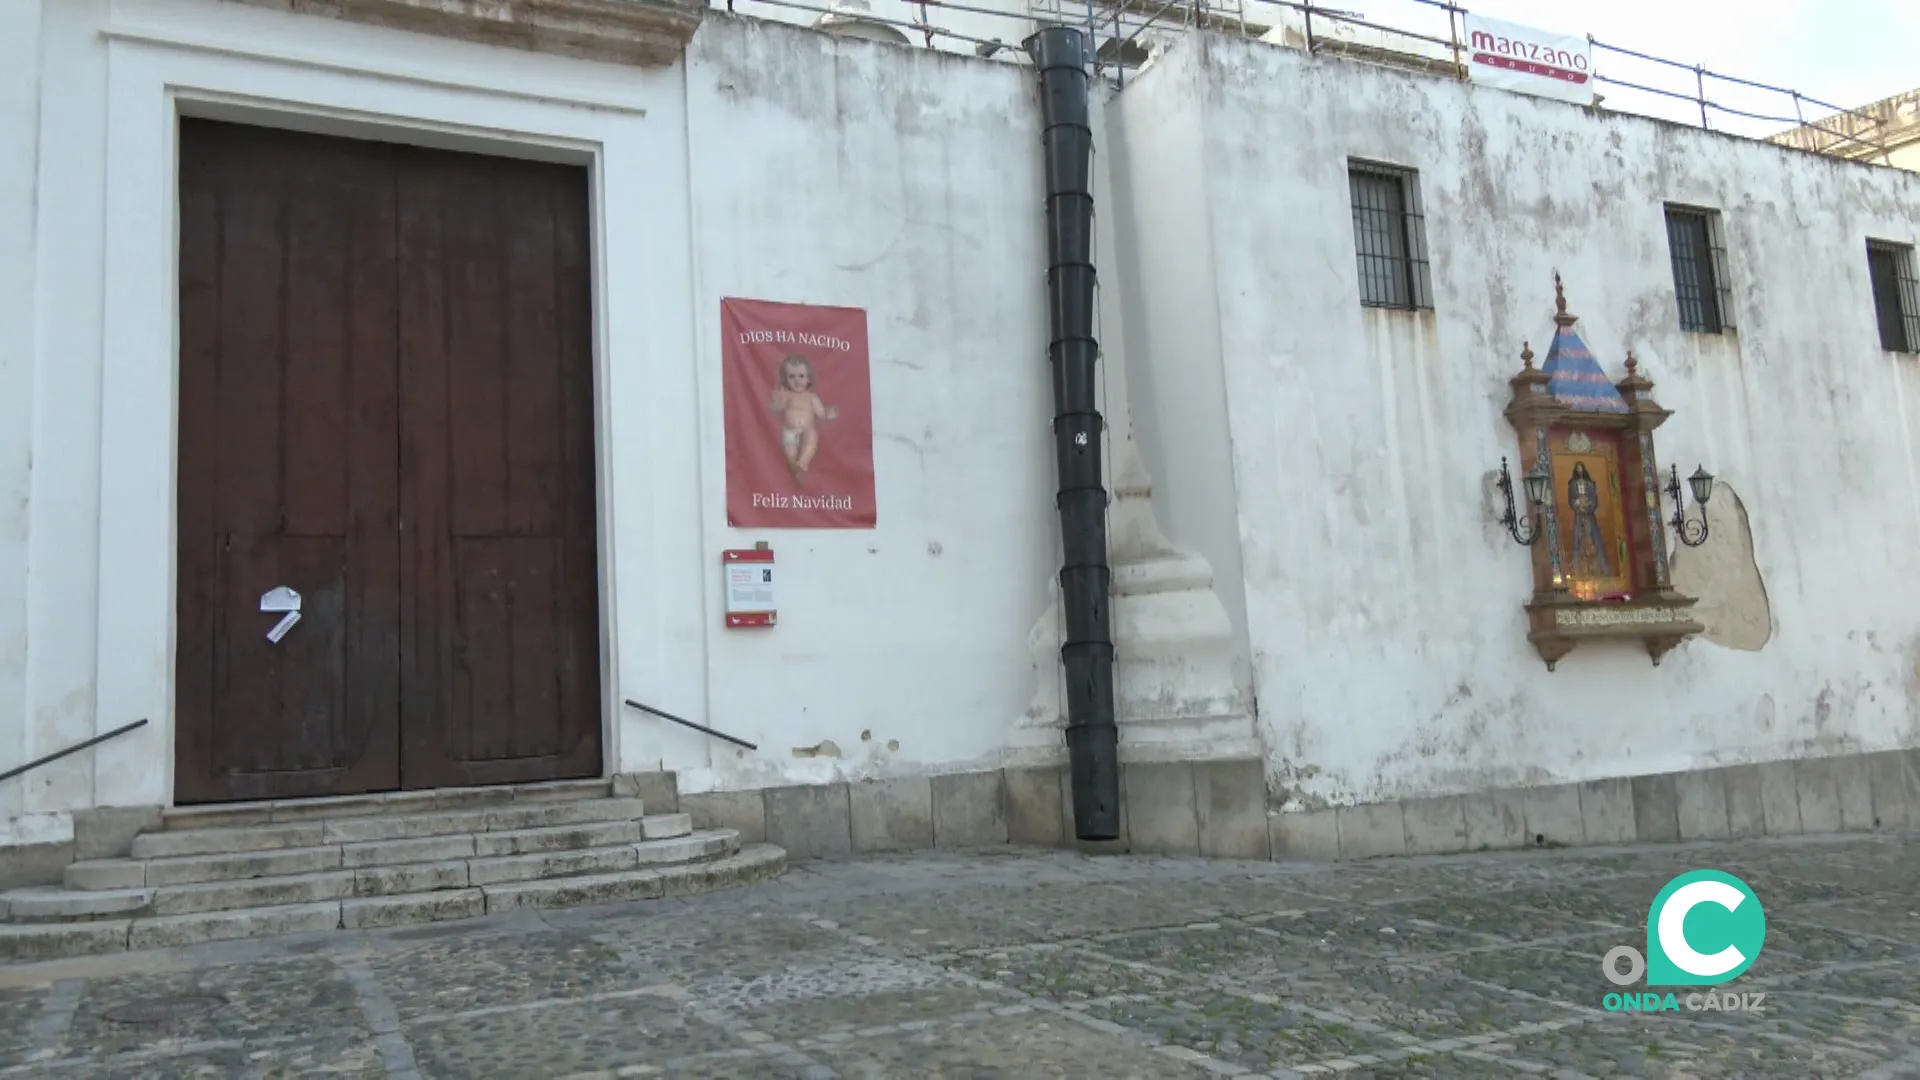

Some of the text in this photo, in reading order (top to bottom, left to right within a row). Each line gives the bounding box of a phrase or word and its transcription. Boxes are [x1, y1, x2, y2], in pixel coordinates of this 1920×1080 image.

[1471, 31, 1587, 70] manzano
[1488, 57, 1574, 80] GRUPO
[740, 331, 850, 351] DIOS HA NACIDO
[752, 493, 852, 510] Feliz Navidad
